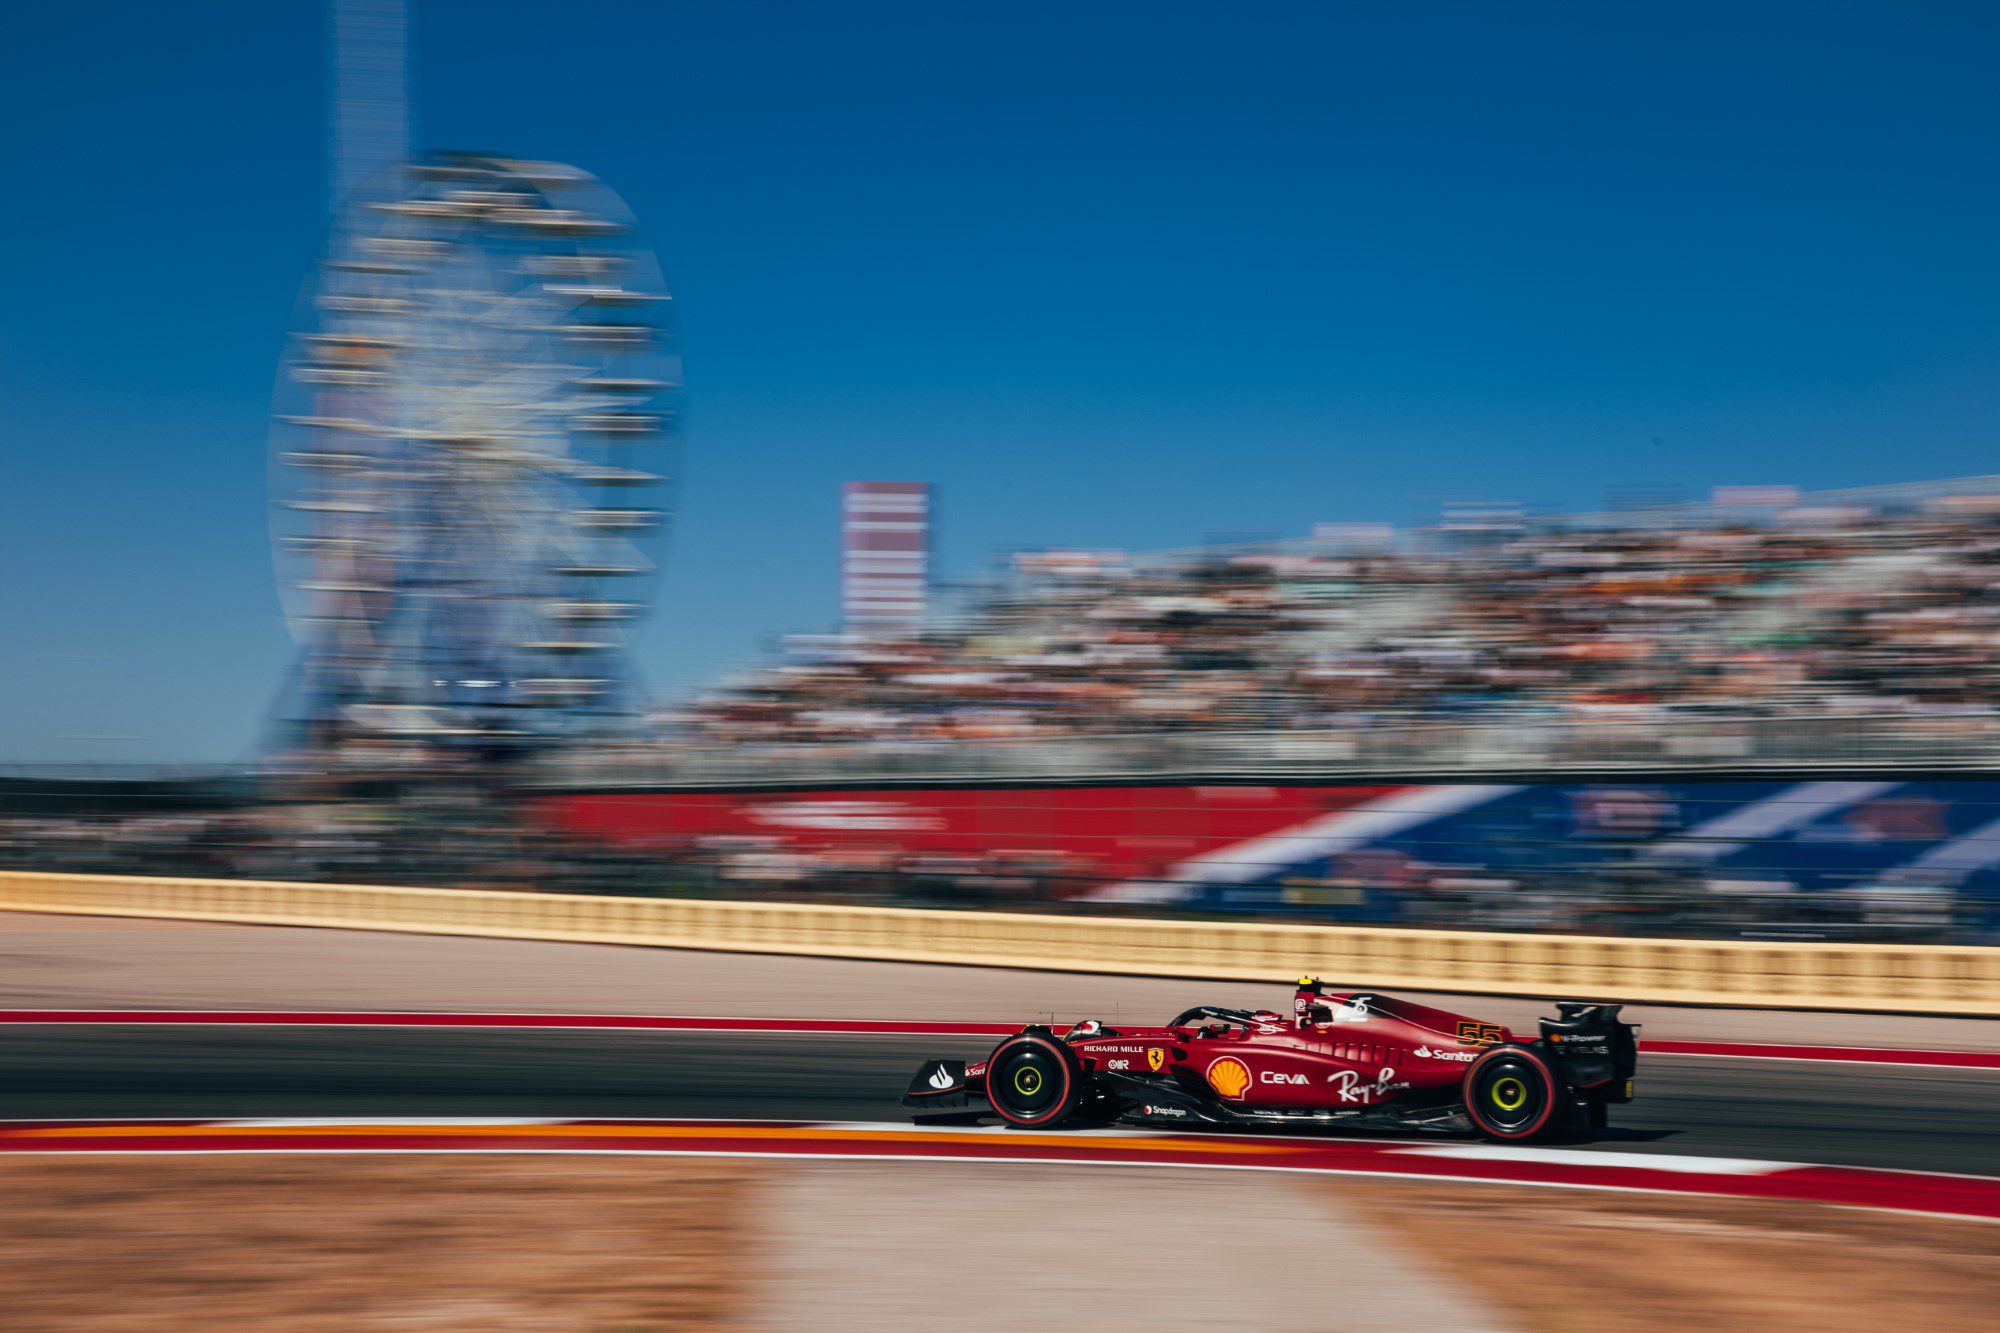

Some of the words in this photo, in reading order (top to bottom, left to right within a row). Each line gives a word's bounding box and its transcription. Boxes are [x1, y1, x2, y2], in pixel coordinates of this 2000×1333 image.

[1455, 1021, 1504, 1049] 55
[1433, 1049, 1479, 1062] Santa
[1152, 1105, 1187, 1118] Snapdragon
